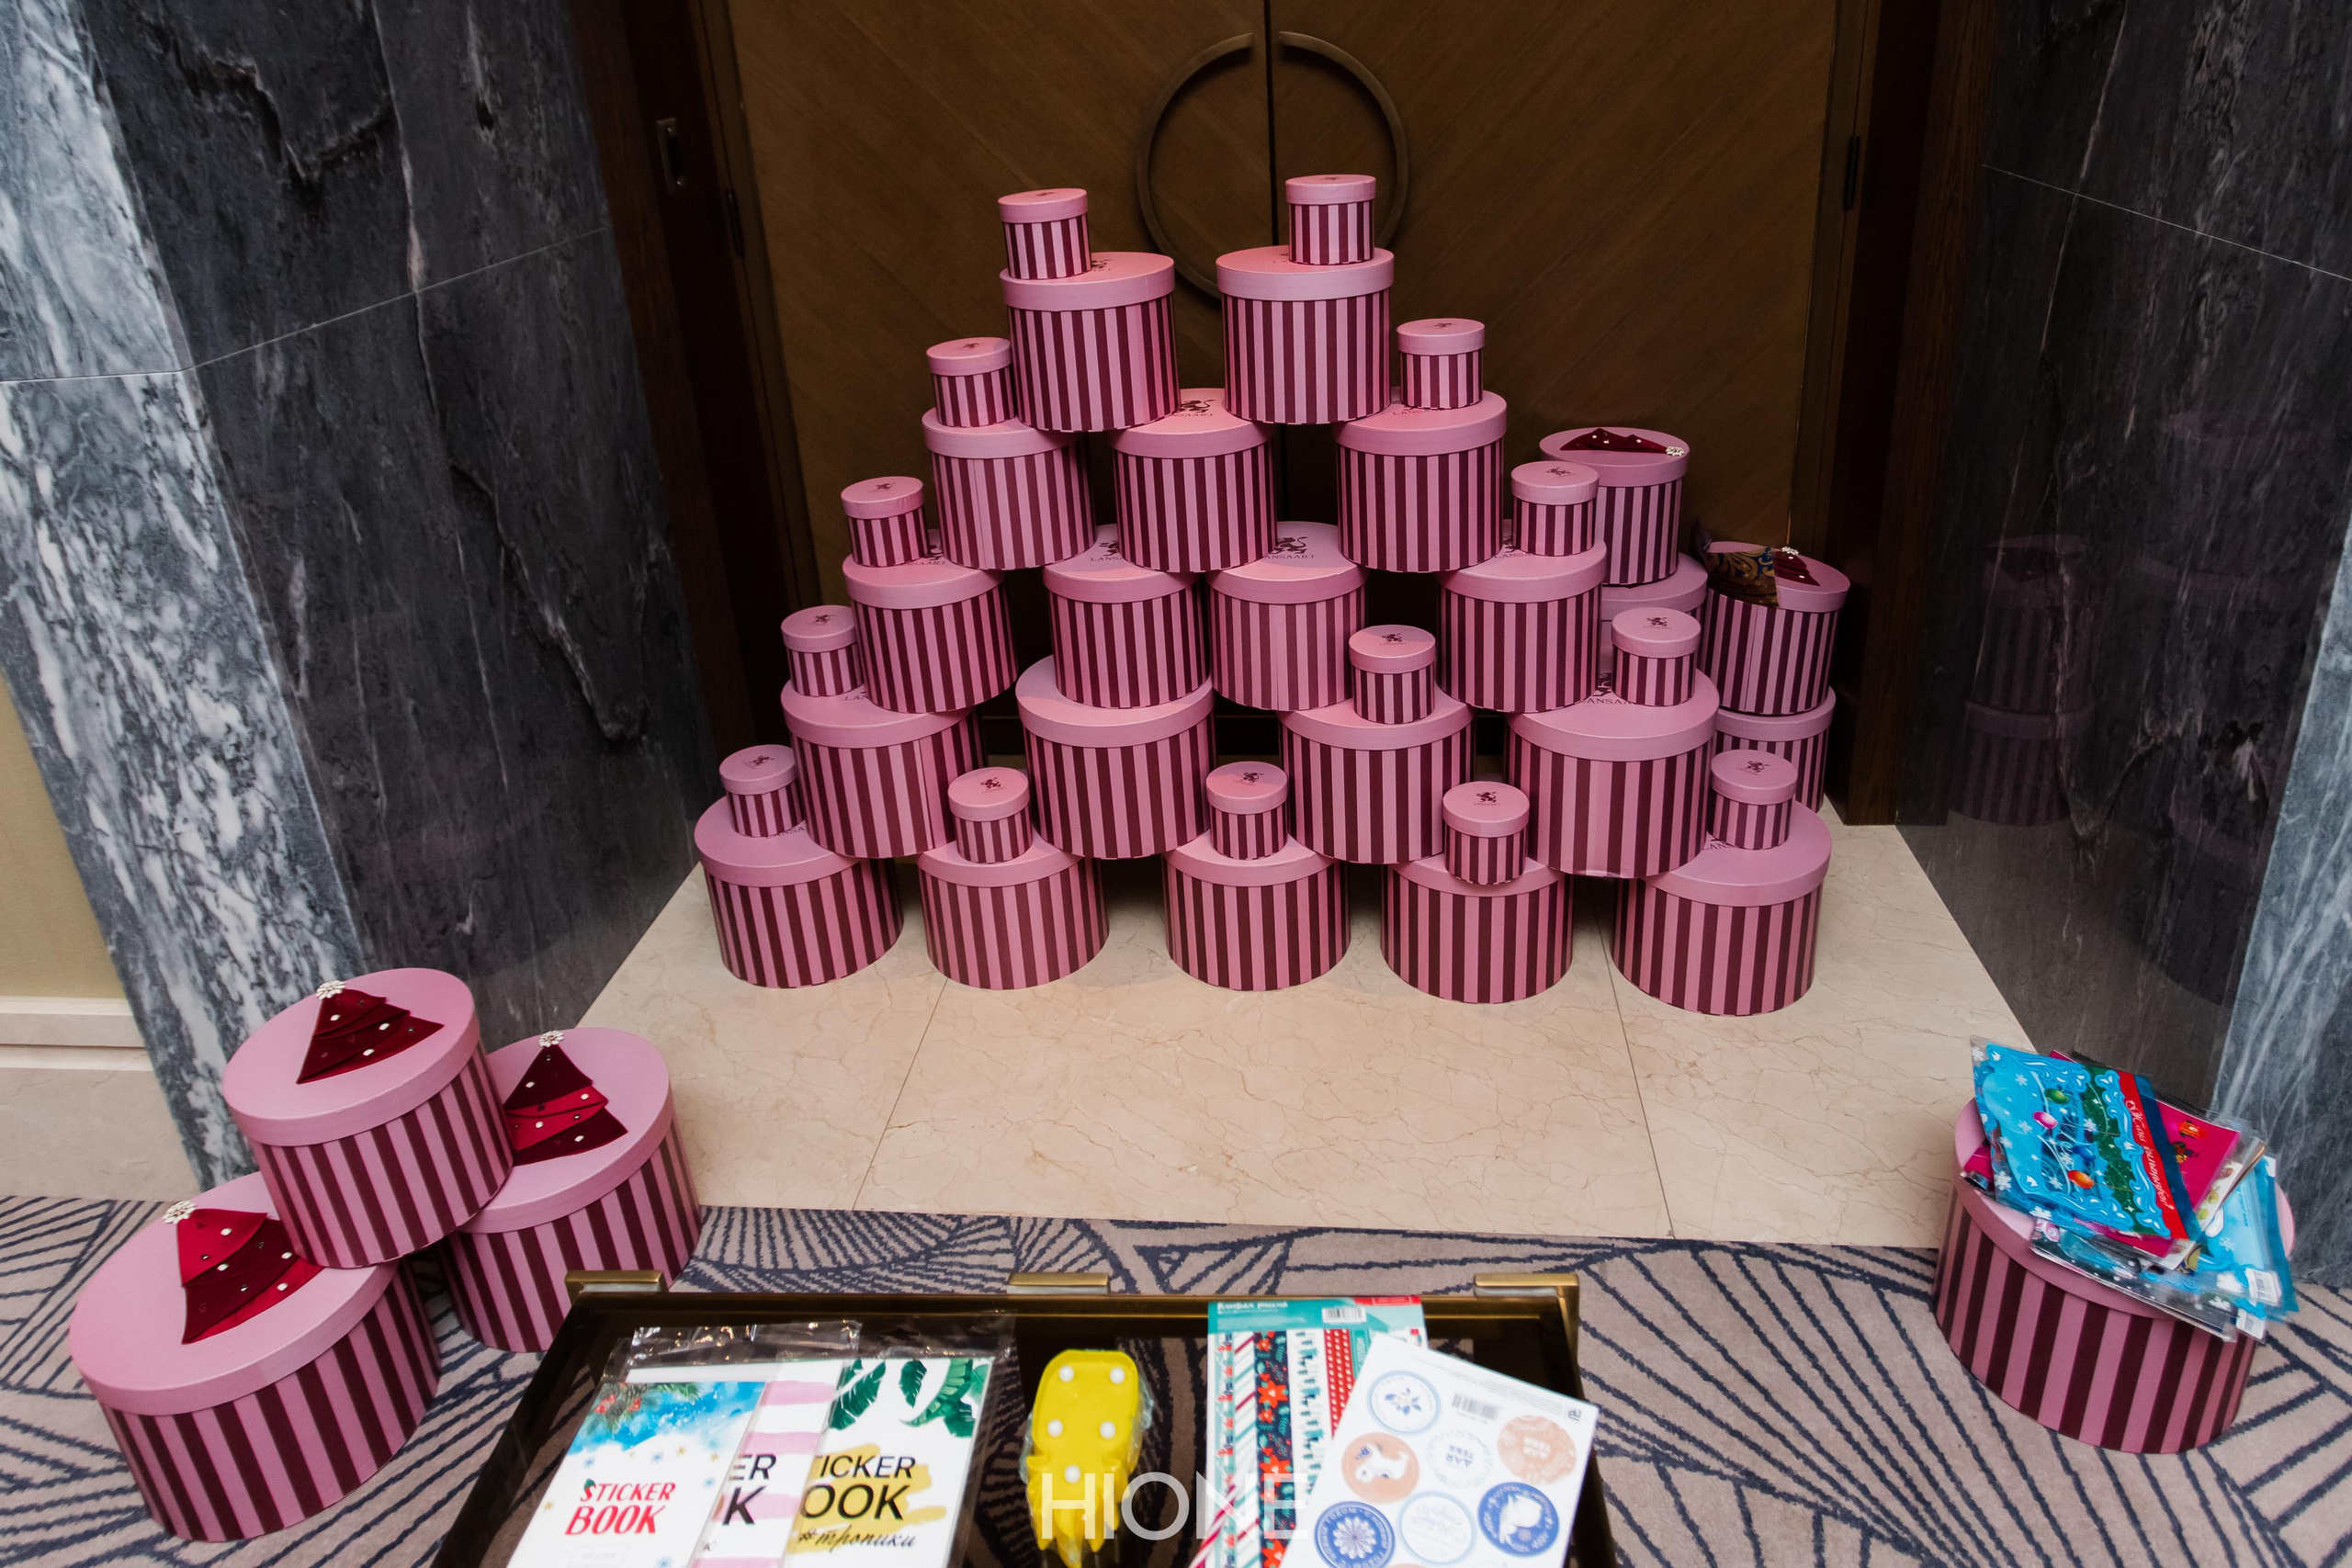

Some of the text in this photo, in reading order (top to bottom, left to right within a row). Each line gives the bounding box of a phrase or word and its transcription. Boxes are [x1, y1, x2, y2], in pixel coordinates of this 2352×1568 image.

[815, 1454, 916, 1479] ICKER
[580, 1479, 676, 1502] STICKER
[564, 1505, 666, 1535] BOOK
